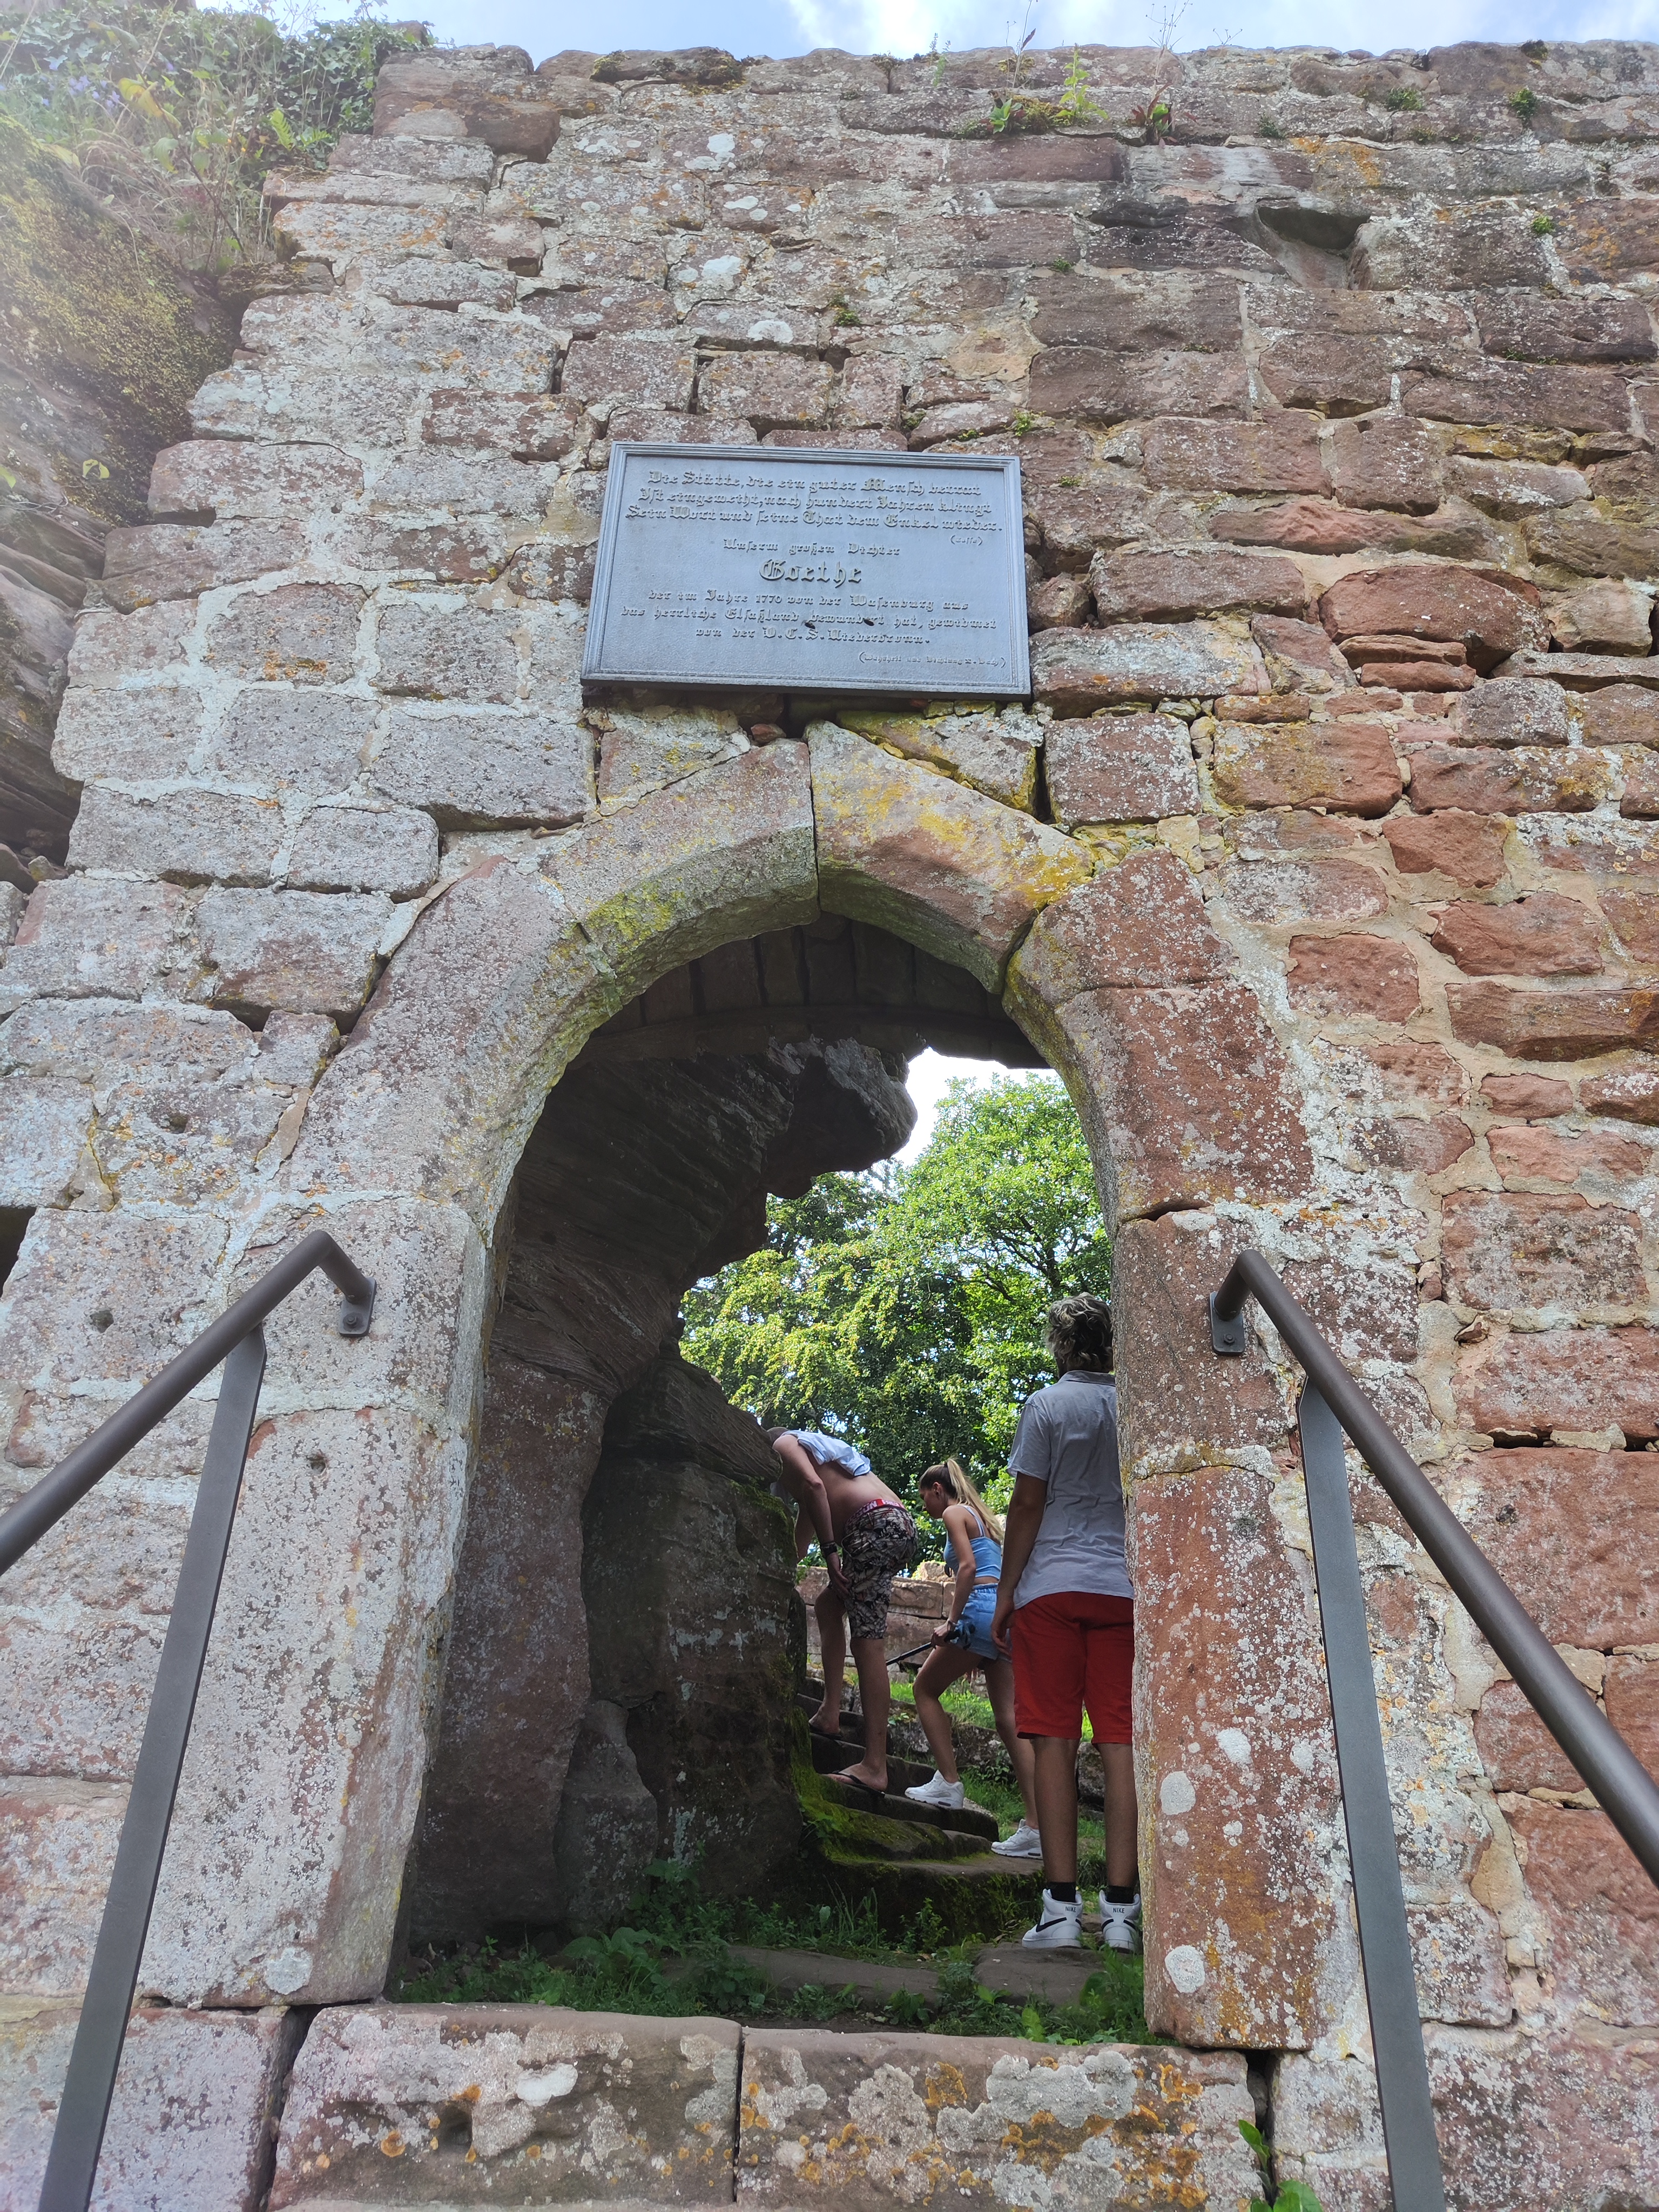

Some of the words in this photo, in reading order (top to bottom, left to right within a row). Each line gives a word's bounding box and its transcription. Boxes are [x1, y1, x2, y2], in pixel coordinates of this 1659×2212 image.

[648, 471, 678, 484] Die
[682, 471, 744, 489] Stätte,
[746, 476, 773, 487] die
[777, 479, 805, 489] ein
[808, 478, 857, 493] guter
[928, 480, 982, 496] betrat
[625, 504, 667, 519] Sein
[670, 505, 717, 521] Wort
[719, 510, 753, 522] und
[847, 512, 879, 527] dem
[883, 514, 939, 529] Enkel
[806, 496, 873, 510] hundert
[876, 496, 934, 512] Jahren
[938, 498, 992, 517] klingt
[789, 542, 835, 555] großen
[847, 542, 900, 557] Dichter
[759, 558, 862, 589] Goethe
[648, 590, 672, 600] der
[677, 591, 697, 601] im
[704, 589, 748, 605] Jahre
[756, 594, 783, 604] 1770
[787, 596, 813, 605] von
[819, 595, 842, 606] der
[942, 601, 969, 610] aus
[621, 606, 645, 616] das
[696, 628, 722, 638] von
[732, 628, 756, 639] der
